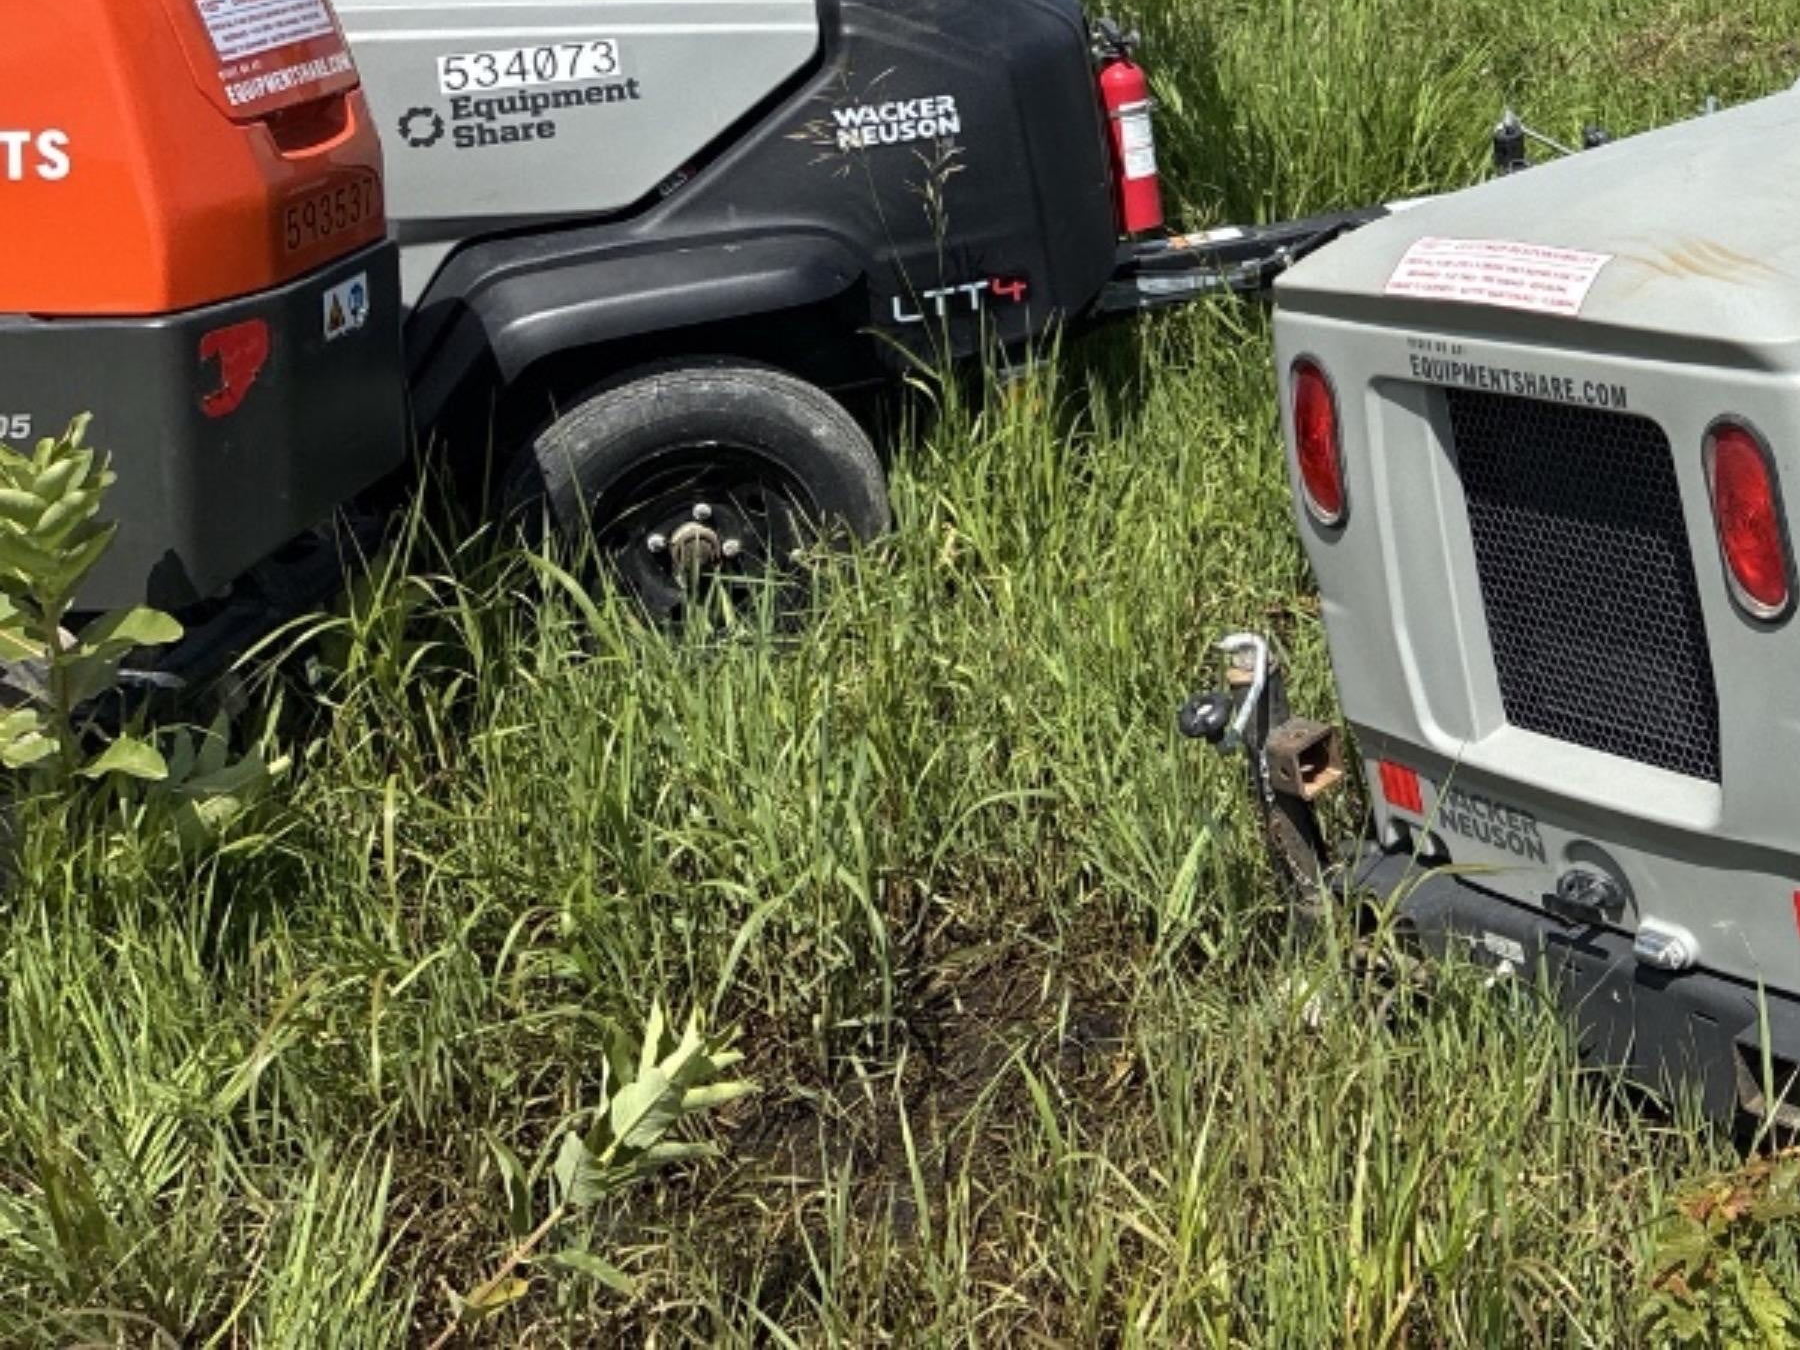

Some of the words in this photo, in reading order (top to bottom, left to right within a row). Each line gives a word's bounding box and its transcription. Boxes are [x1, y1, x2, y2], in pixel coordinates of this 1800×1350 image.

[444, 41, 617, 90] 534073
[451, 77, 640, 122] Equipment
[832, 95, 957, 127] WACKER
[0, 128, 71, 181] TS
[452, 119, 556, 149] Share
[836, 114, 961, 150] NEUSON
[287, 177, 373, 249] 593537
[892, 278, 1027, 322] LTT4
[1410, 354, 1627, 408] EQUIPMENTSHARE.COM
[1440, 807, 1546, 864] NEUSON
